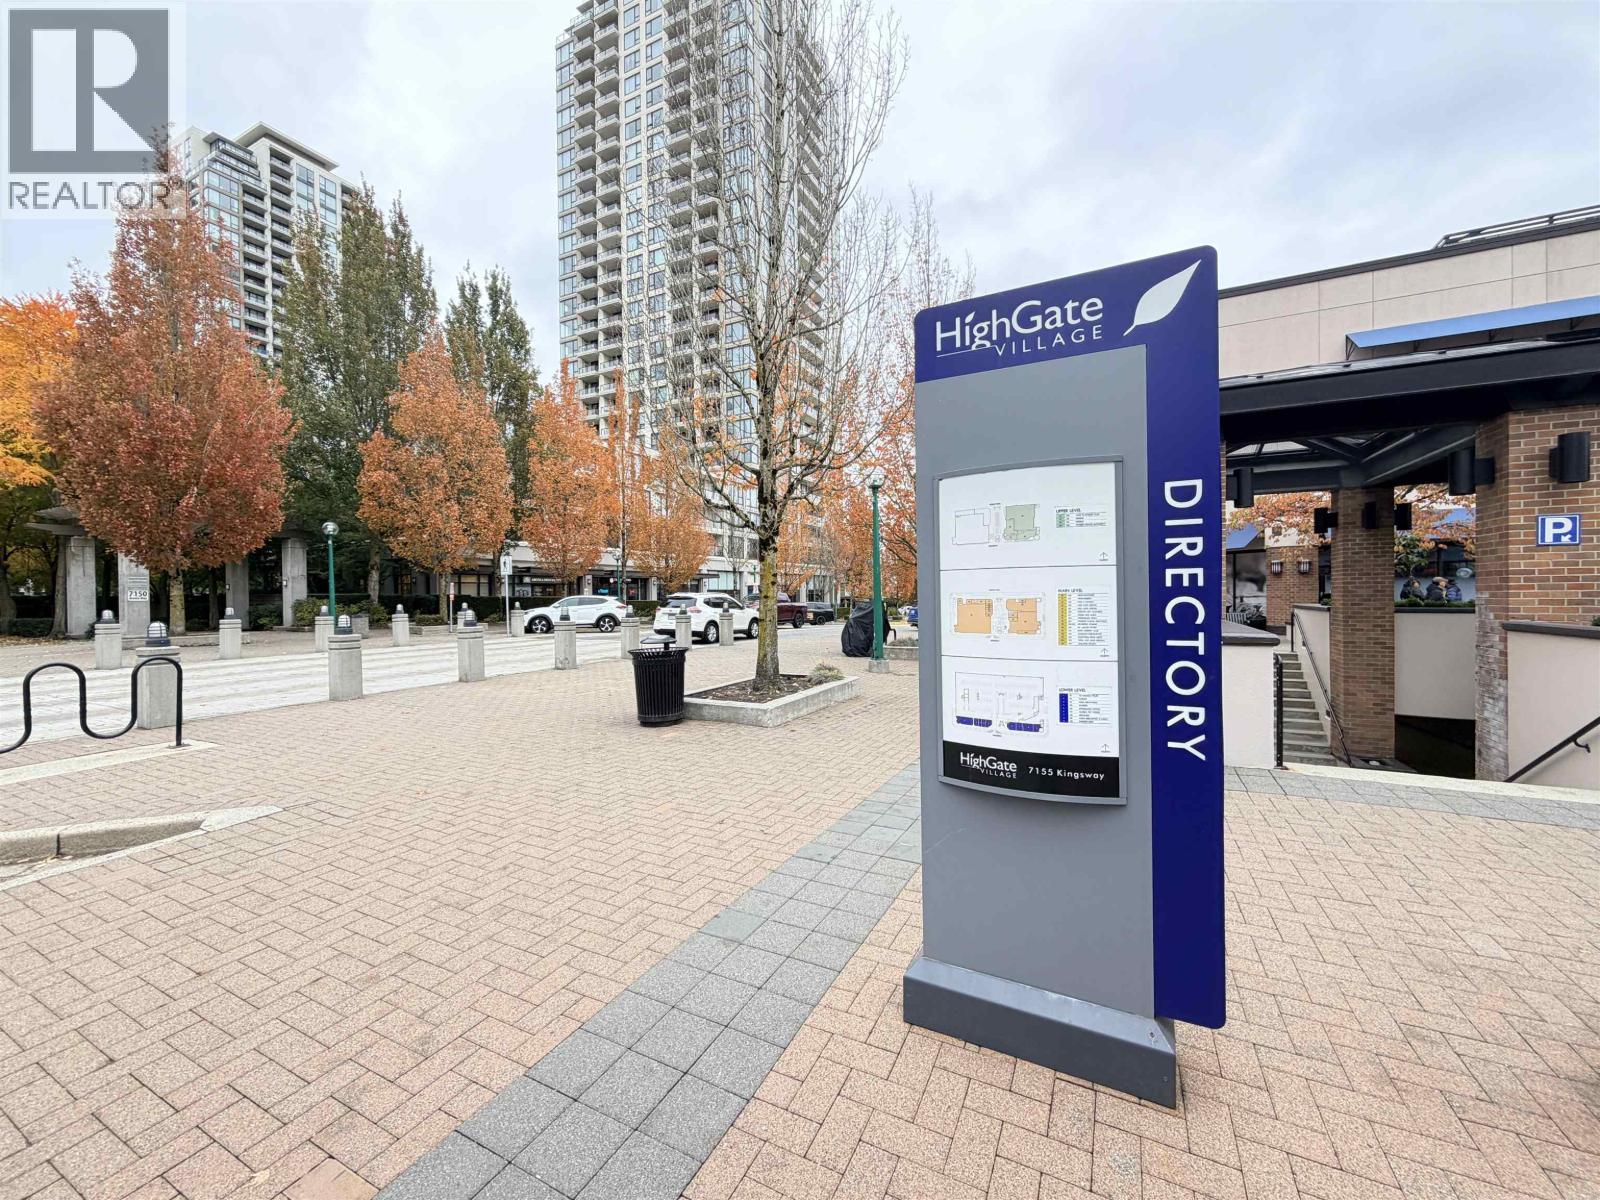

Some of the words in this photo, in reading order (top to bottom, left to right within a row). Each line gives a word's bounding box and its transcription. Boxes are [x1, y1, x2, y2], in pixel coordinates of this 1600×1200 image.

[936, 297, 1103, 351] HighGate
[996, 325, 1102, 356] VILLAGE
[1545, 517, 1572, 543] P
[1164, 478, 1206, 761] DIRECTORY
[960, 752, 1017, 772] HighGate
[1028, 766, 1053, 776] 7155
[1057, 769, 1105, 780] Kingsway
[980, 768, 1017, 779] VILLAGE
